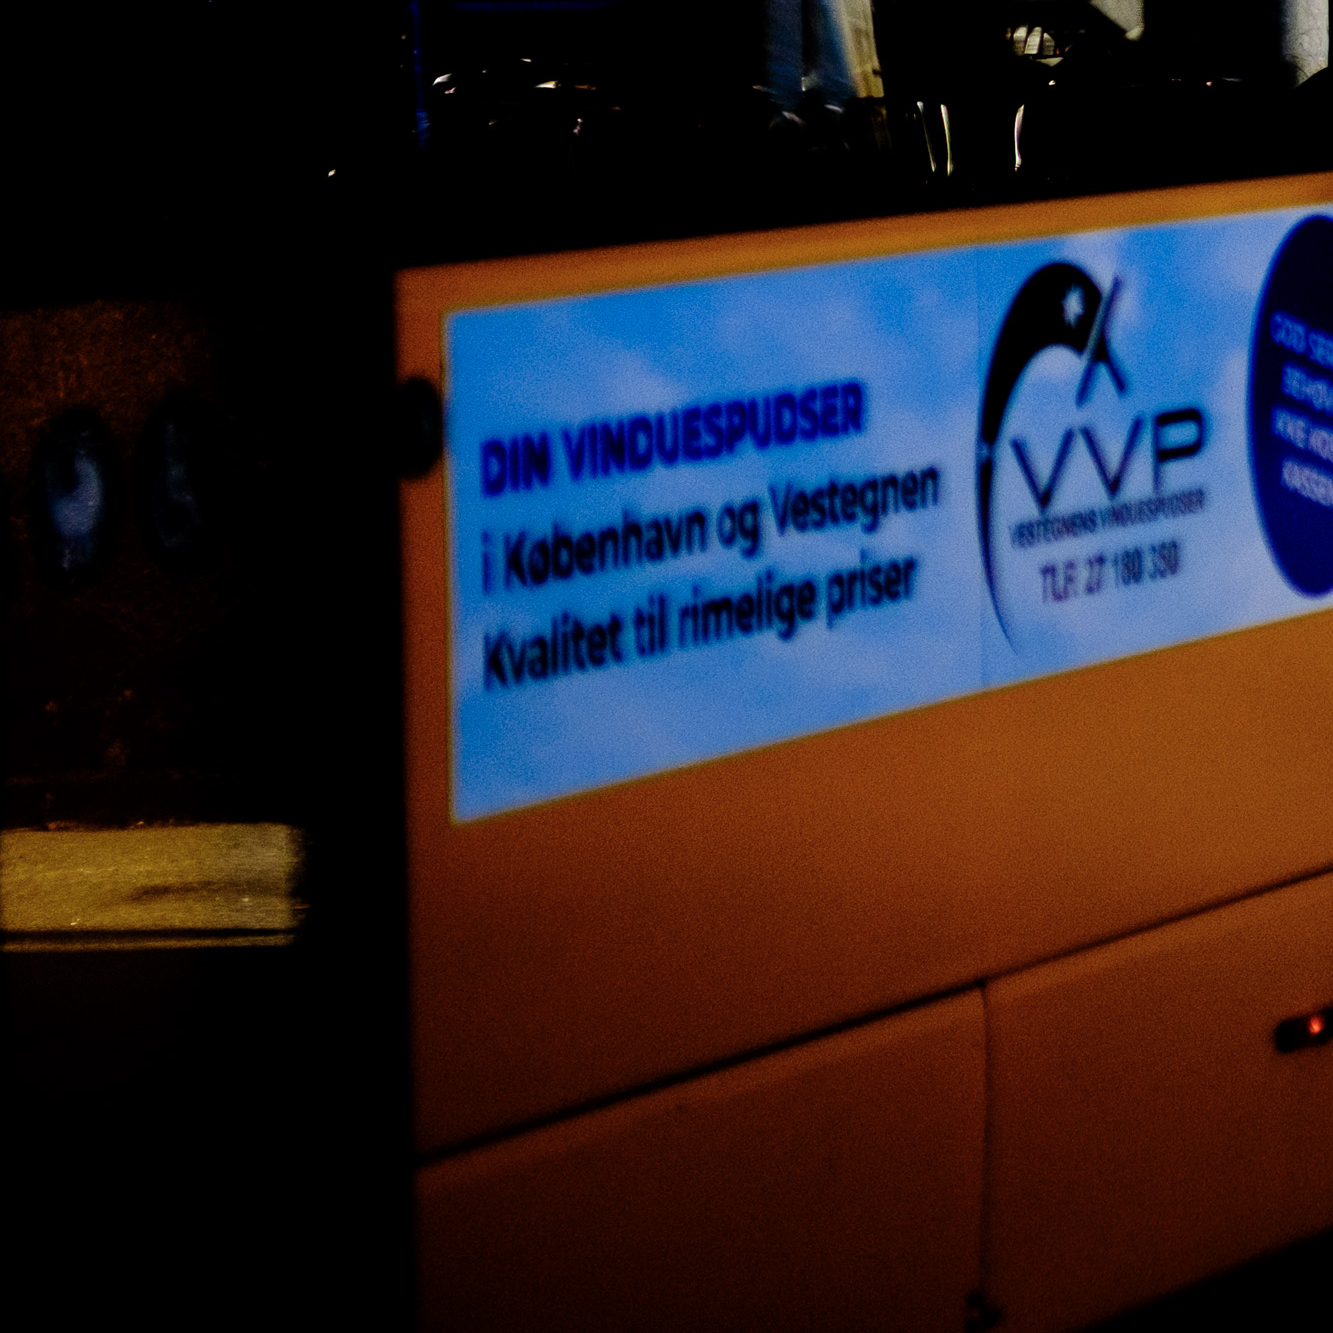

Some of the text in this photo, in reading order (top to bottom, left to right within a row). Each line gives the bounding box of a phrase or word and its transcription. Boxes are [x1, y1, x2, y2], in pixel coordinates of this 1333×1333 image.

[481, 378, 867, 497] DIN VINDUESPUDSER
[1010, 408, 1205, 513] VVP
[480, 465, 940, 593] i København og Vestegnen
[1085, 553, 1106, 595] 27
[483, 546, 918, 691] Kvalitet til rimelige priser
